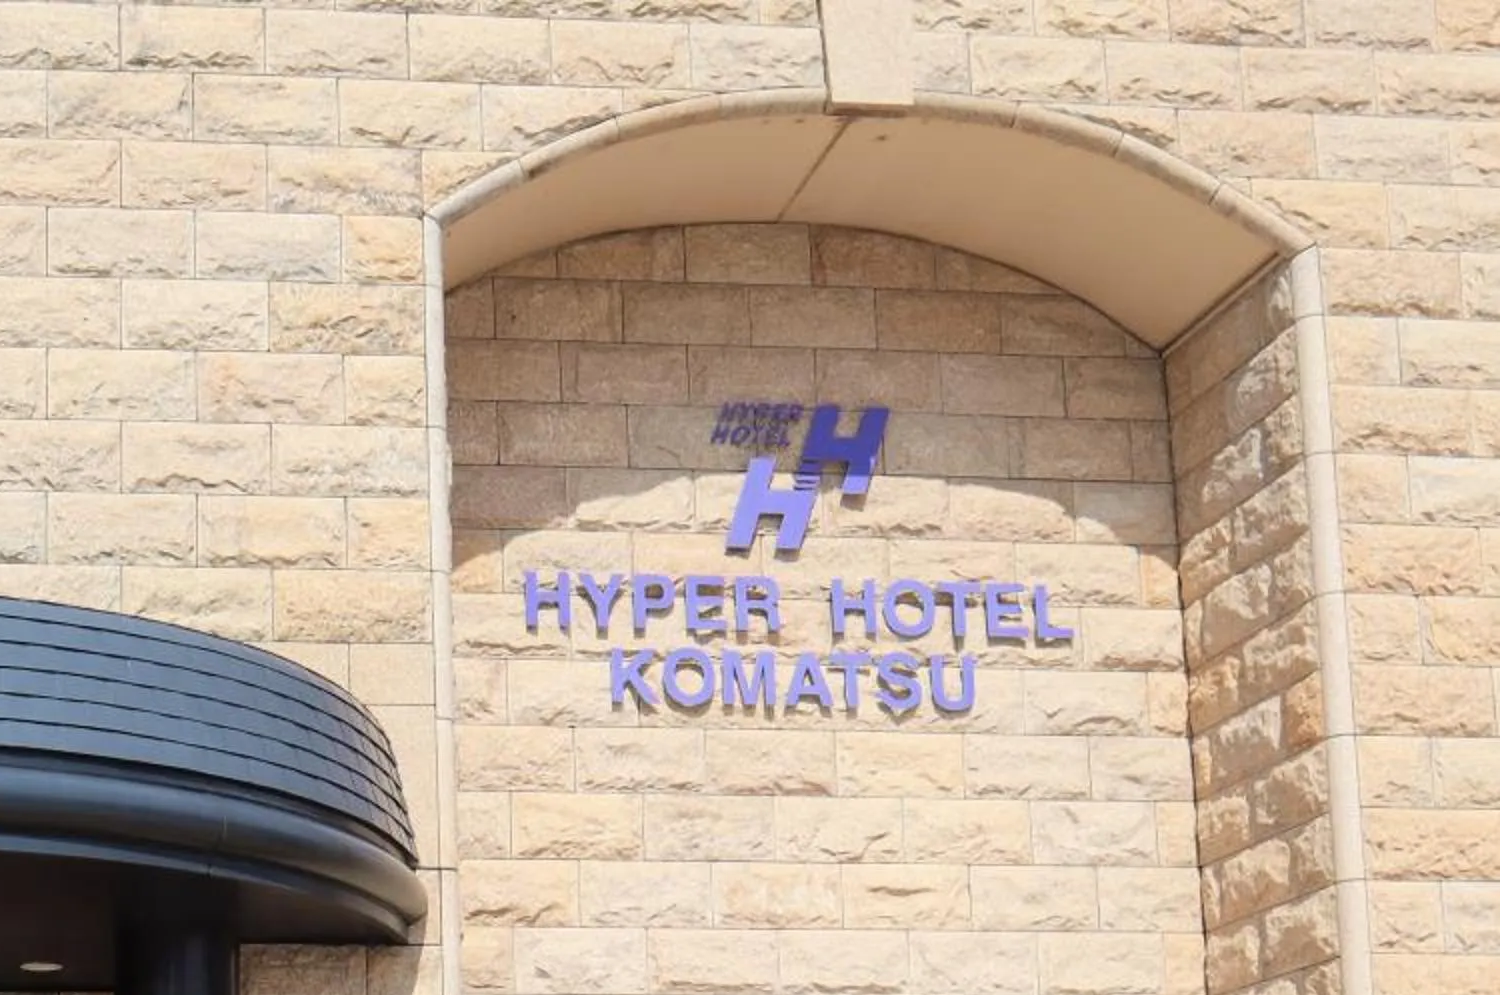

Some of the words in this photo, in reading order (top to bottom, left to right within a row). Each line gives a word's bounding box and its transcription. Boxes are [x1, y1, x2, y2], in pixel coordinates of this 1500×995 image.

[719, 401, 804, 424] HYPER
[711, 424, 791, 447] HOTEL
[523, 570, 781, 638] HYPER
[832, 578, 1074, 641] HOTEL
[610, 648, 976, 716] KOMATSU
